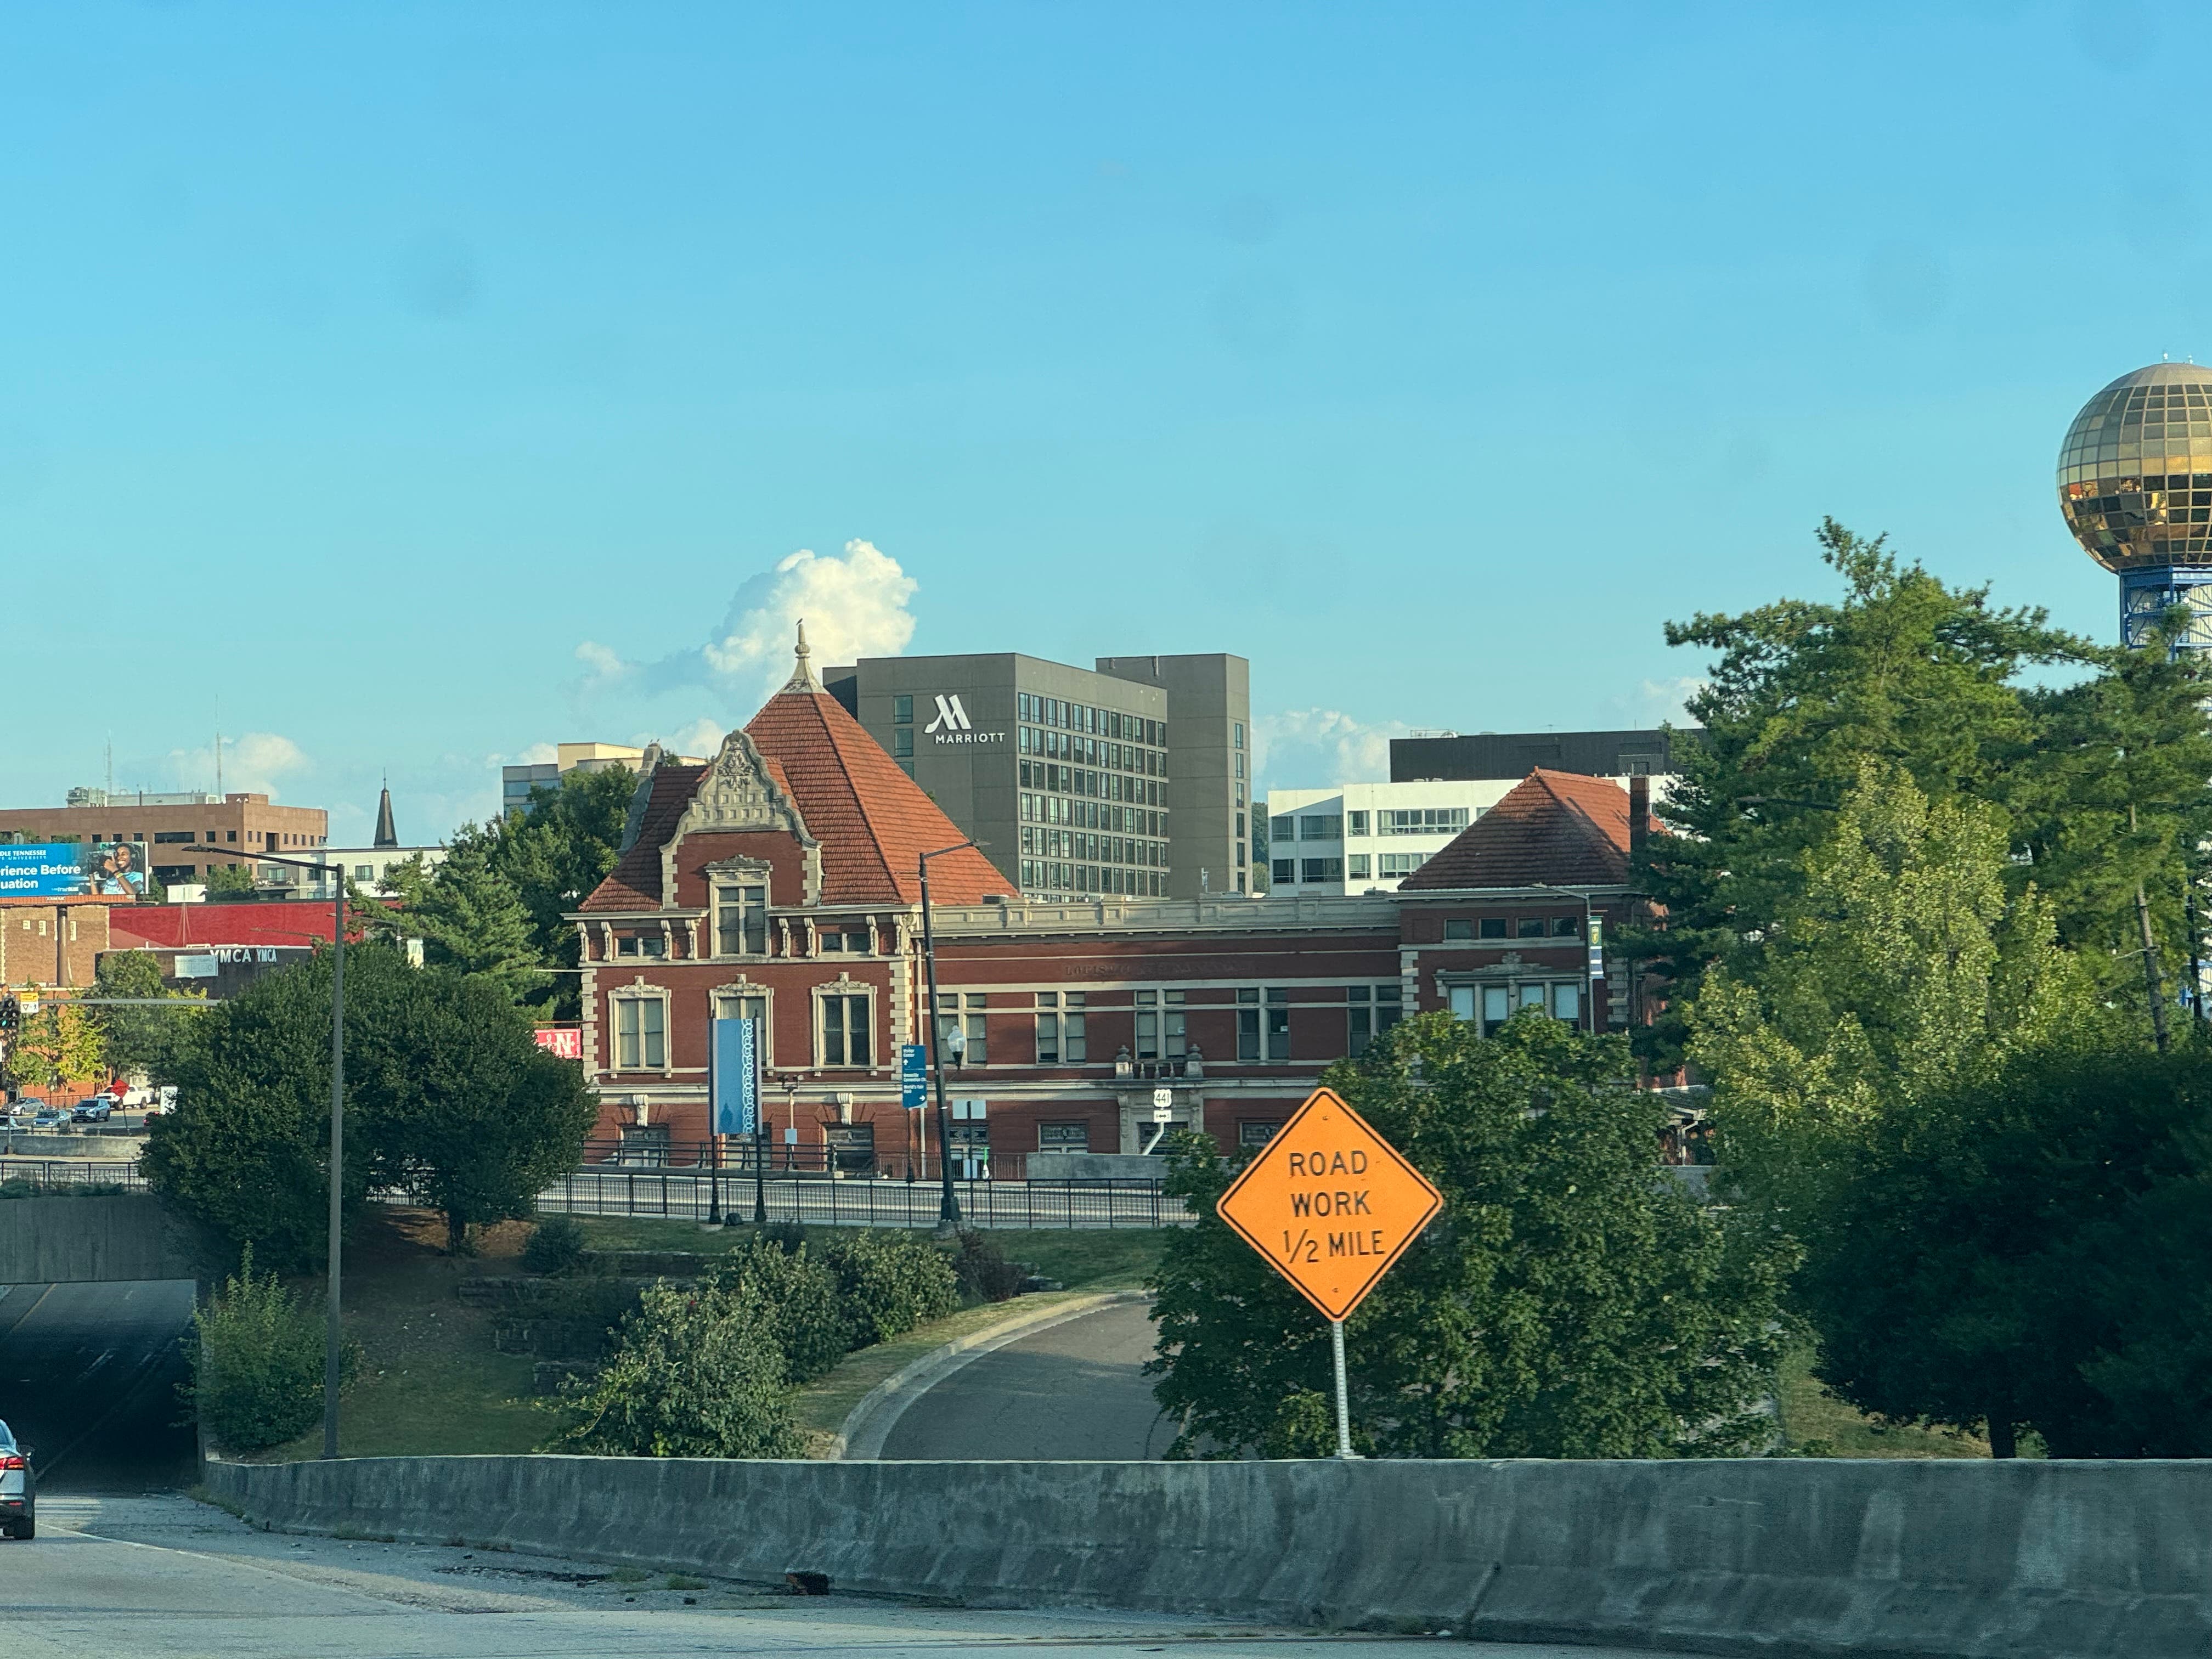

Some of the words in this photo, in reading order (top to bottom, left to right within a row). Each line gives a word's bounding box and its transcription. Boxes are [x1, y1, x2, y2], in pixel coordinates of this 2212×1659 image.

[935, 733, 1005, 744] MARRIOTT
[0, 865, 38, 876] rience
[41, 864, 81, 875] Before
[1, 878, 38, 889] uation
[210, 949, 252, 963] YMCA
[256, 949, 277, 962] YMCA
[1155, 1093, 1170, 1103] 441
[1290, 1150, 1368, 1176] ROAD
[1290, 1190, 1372, 1217] WORK
[1283, 1228, 1319, 1263] 1/2
[1328, 1230, 1386, 1257] MILE
